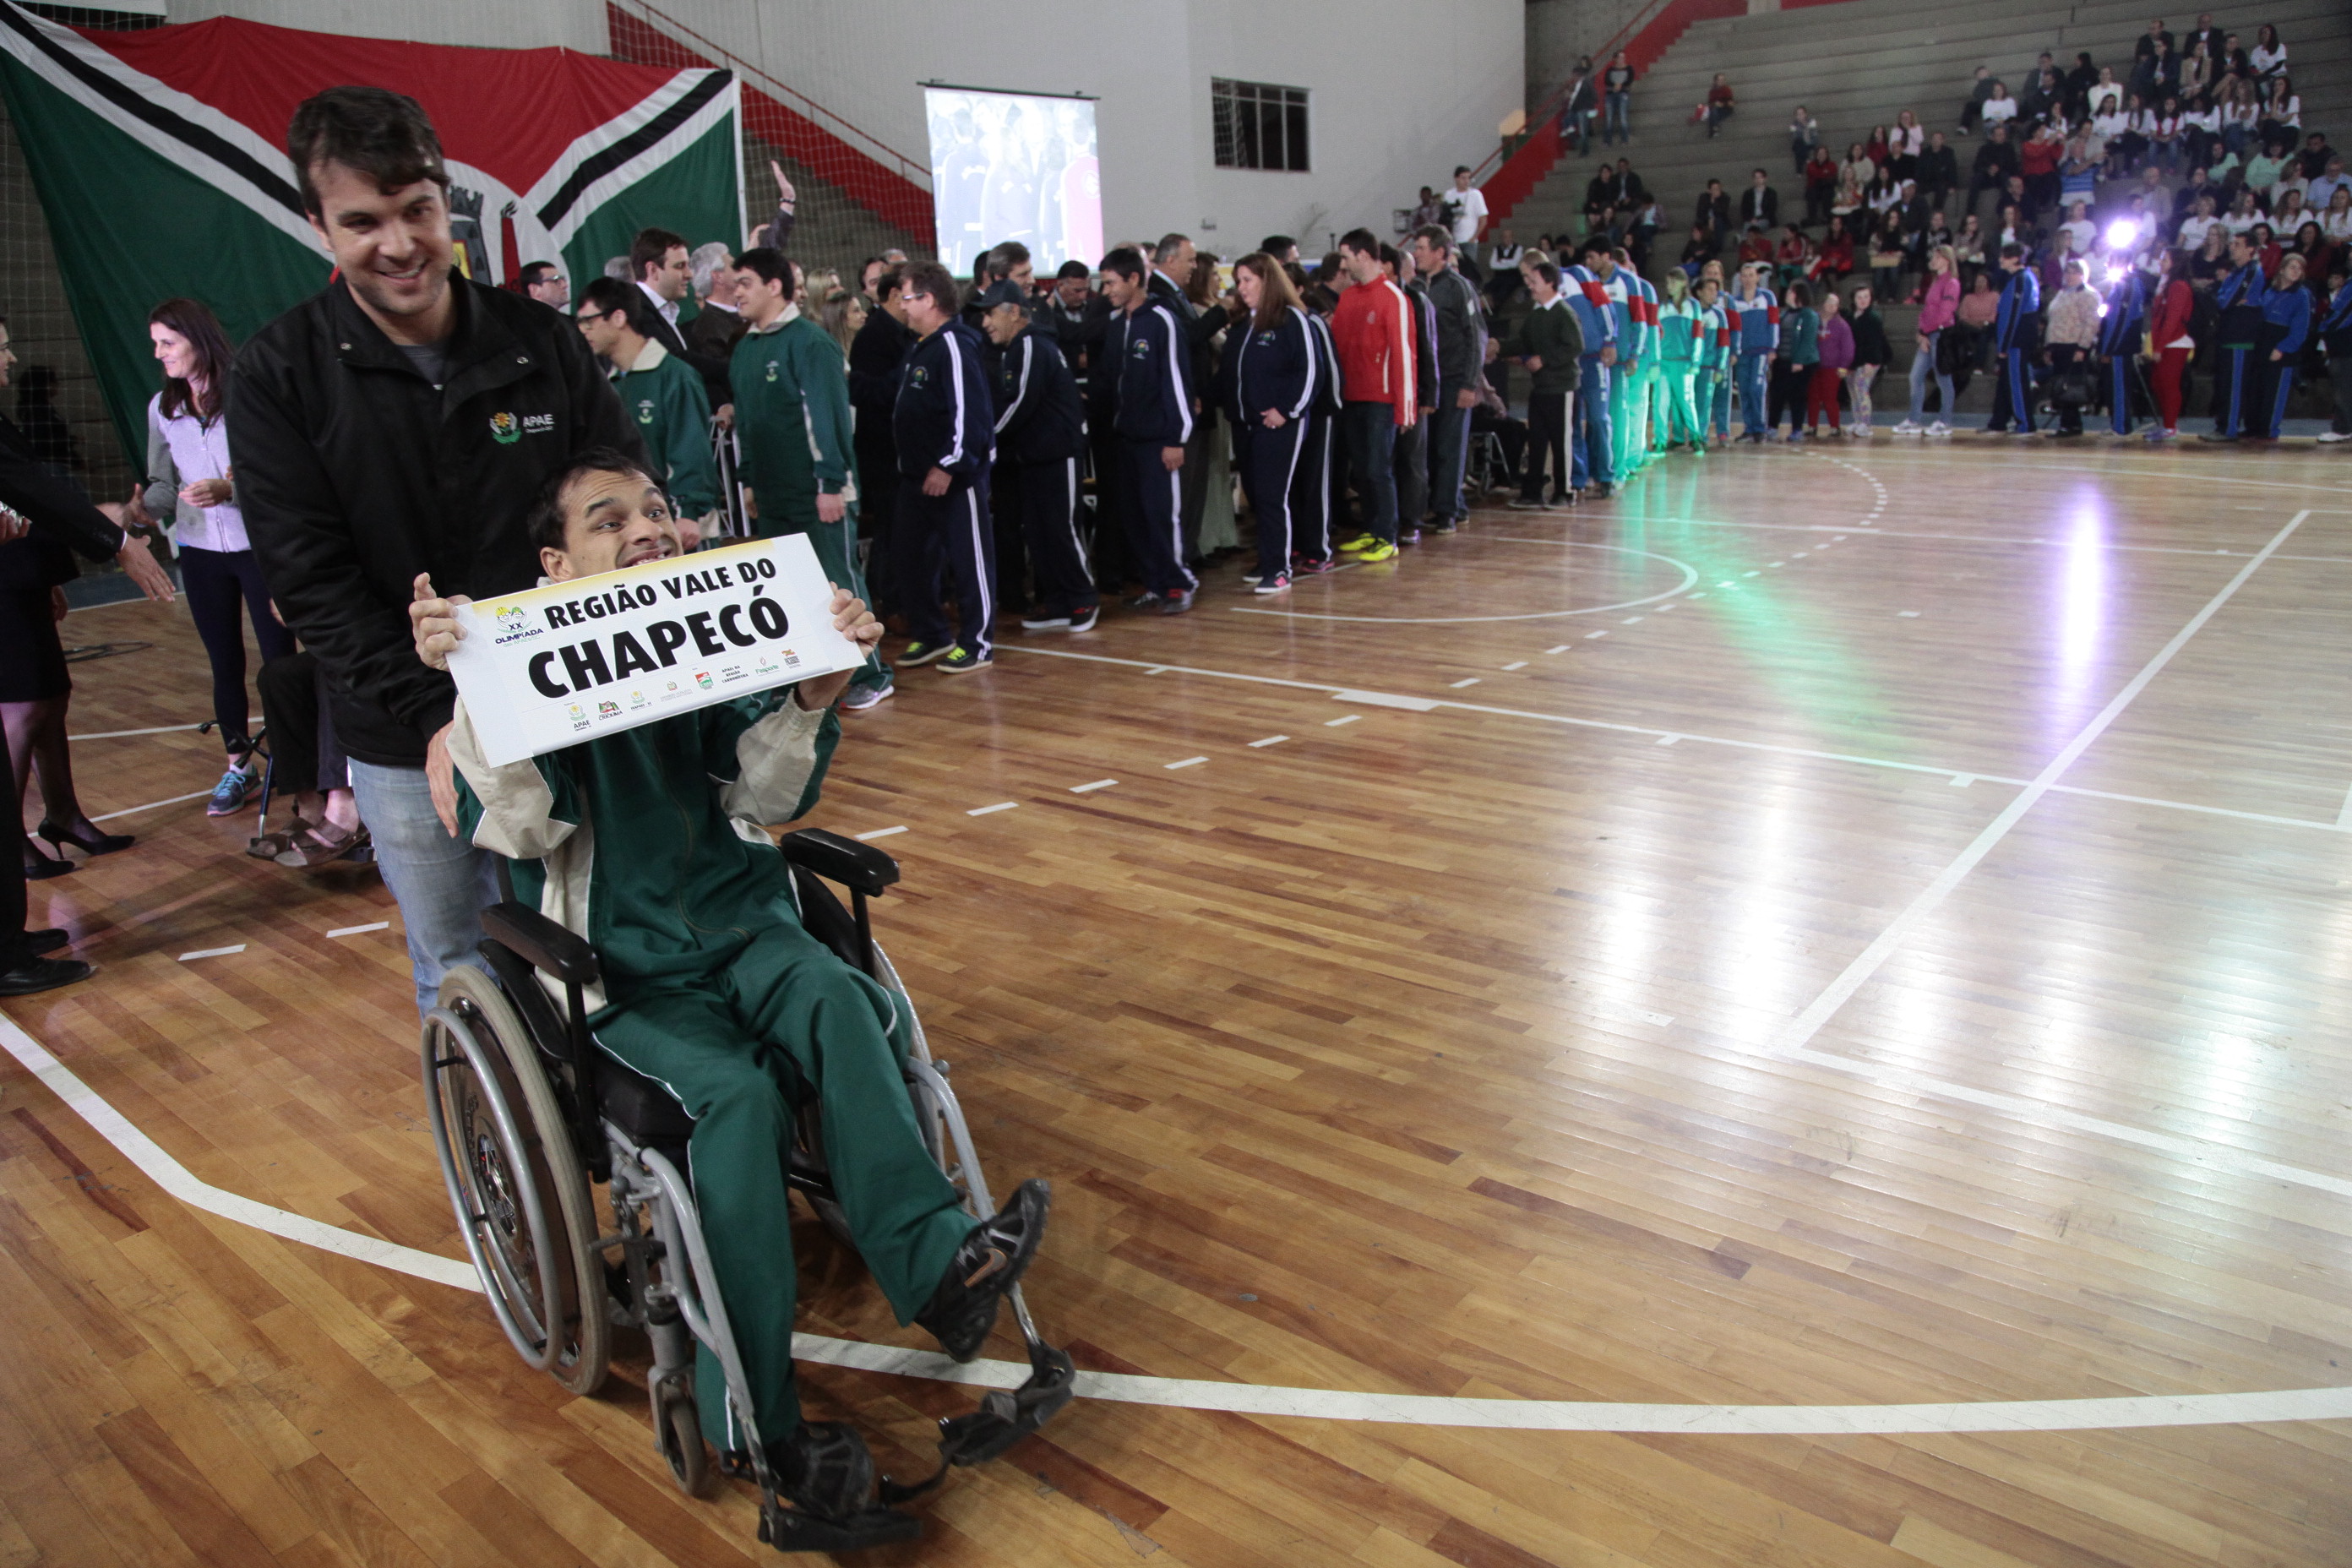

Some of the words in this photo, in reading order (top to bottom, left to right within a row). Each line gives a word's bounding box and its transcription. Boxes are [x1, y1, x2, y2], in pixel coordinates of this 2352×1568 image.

[523, 414, 555, 427] APAE
[544, 583, 657, 629] REGIÃO
[661, 566, 733, 599] VALE
[736, 558, 776, 583] DO
[509, 622, 523, 630] XX
[495, 629, 544, 644] OLIMPÍADA
[528, 584, 789, 699] CHAPECÓ
[574, 719, 591, 729] APAE
